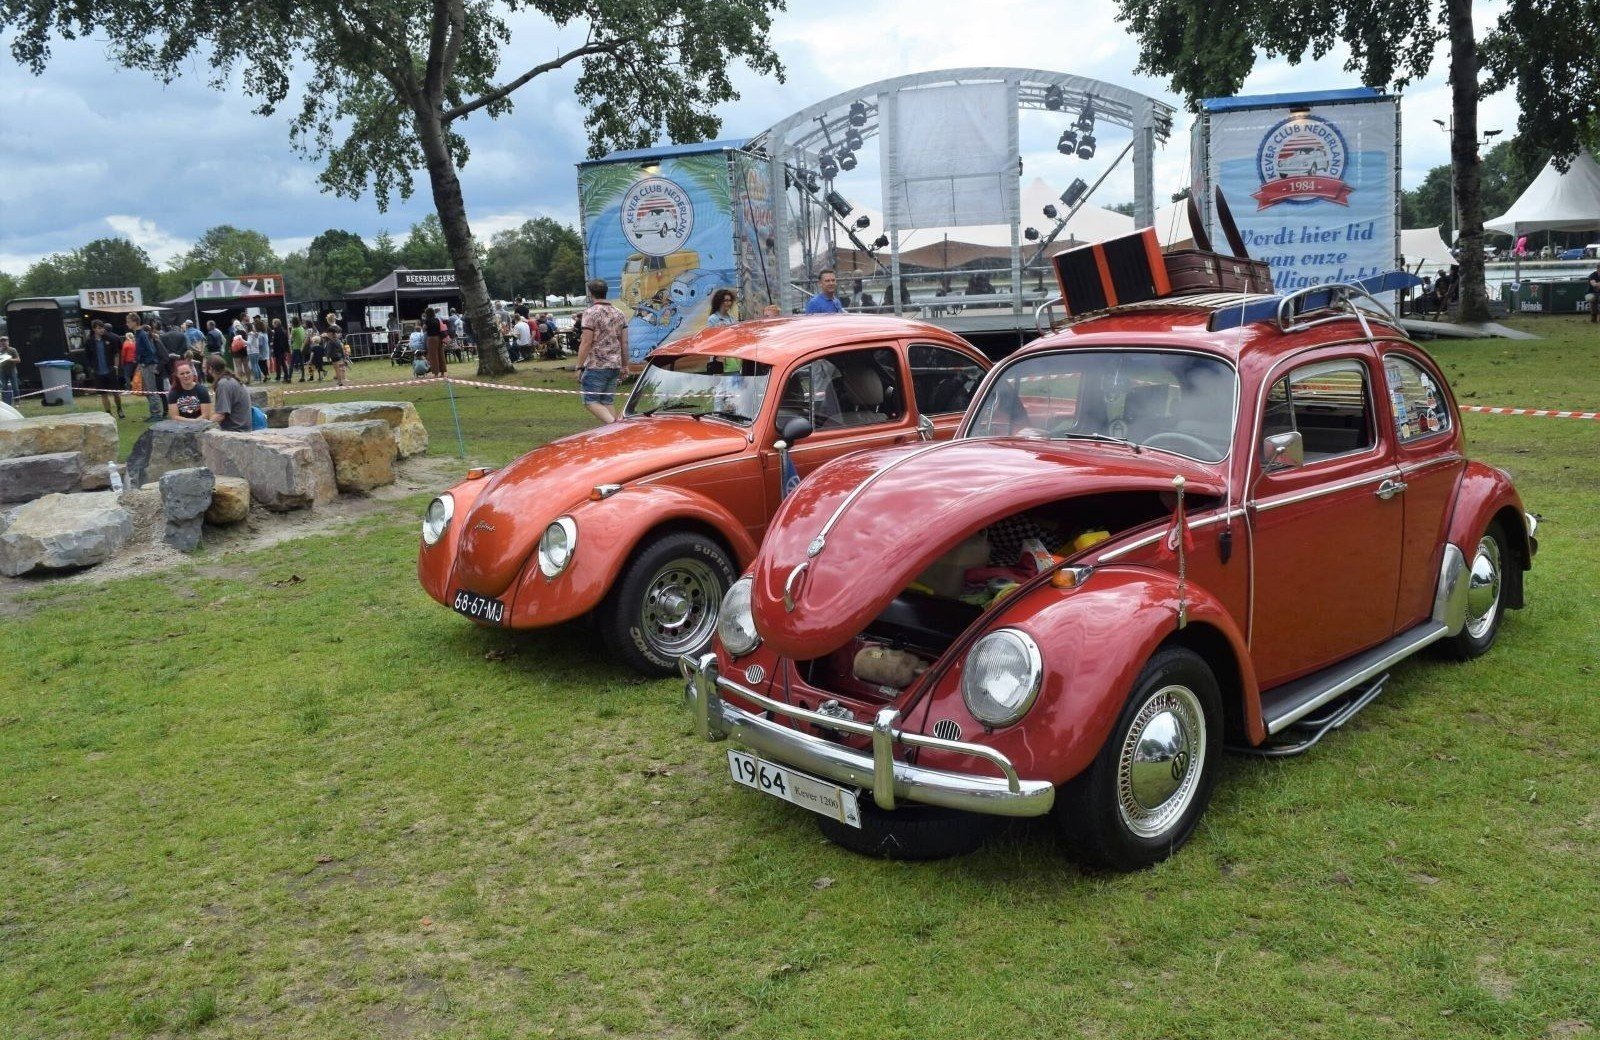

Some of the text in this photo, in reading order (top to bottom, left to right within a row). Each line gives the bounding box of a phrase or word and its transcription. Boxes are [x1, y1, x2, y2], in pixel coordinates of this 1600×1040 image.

[1265, 124, 1341, 179] KEVER CLUB NEDERLAND
[1289, 181, 1315, 192] 1984
[627, 184, 687, 239] KEVER CLUB NEDERLAND
[1300, 225, 1341, 244] hier
[1346, 221, 1374, 241] lid
[1300, 251, 1347, 266] onze
[202, 277, 276, 299] PIZZA
[406, 274, 456, 283] BEEFBURGERS
[87, 289, 135, 306] FRITES
[454, 592, 504, 622] 68-67-MJ
[734, 756, 786, 796] 1964
[794, 785, 817, 802] Kever
